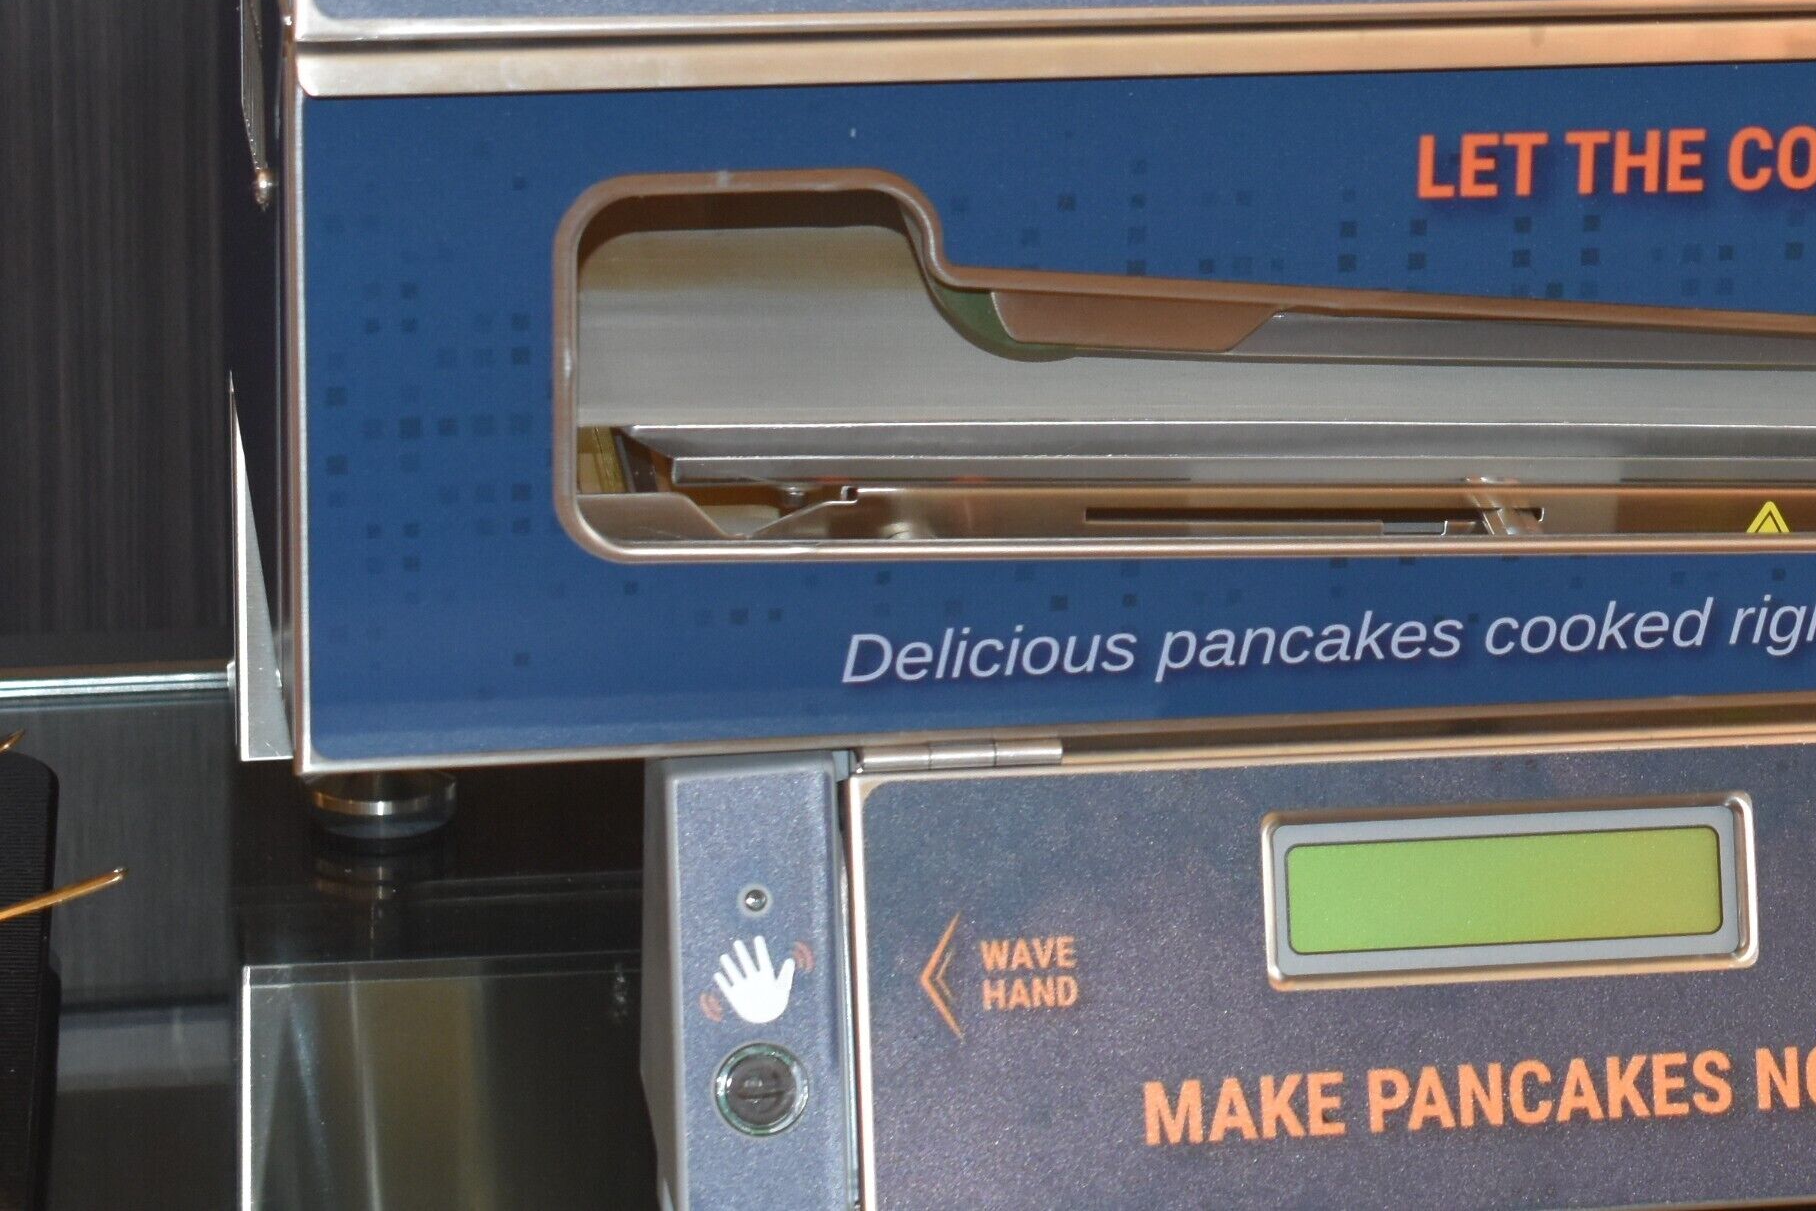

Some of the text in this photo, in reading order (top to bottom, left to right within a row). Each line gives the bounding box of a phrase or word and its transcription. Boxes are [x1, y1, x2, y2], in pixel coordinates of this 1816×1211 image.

[1417, 133, 1549, 200] LET
[1566, 129, 1707, 196] THE
[841, 624, 1138, 684] Delicious
[1154, 610, 1464, 684] pancakes
[1485, 596, 1715, 656] cooked
[980, 935, 1077, 972] WAVE
[983, 974, 1079, 1011] HAND
[1143, 1070, 1347, 1147] MAKE
[1367, 1049, 1734, 1135] PANCAKES
